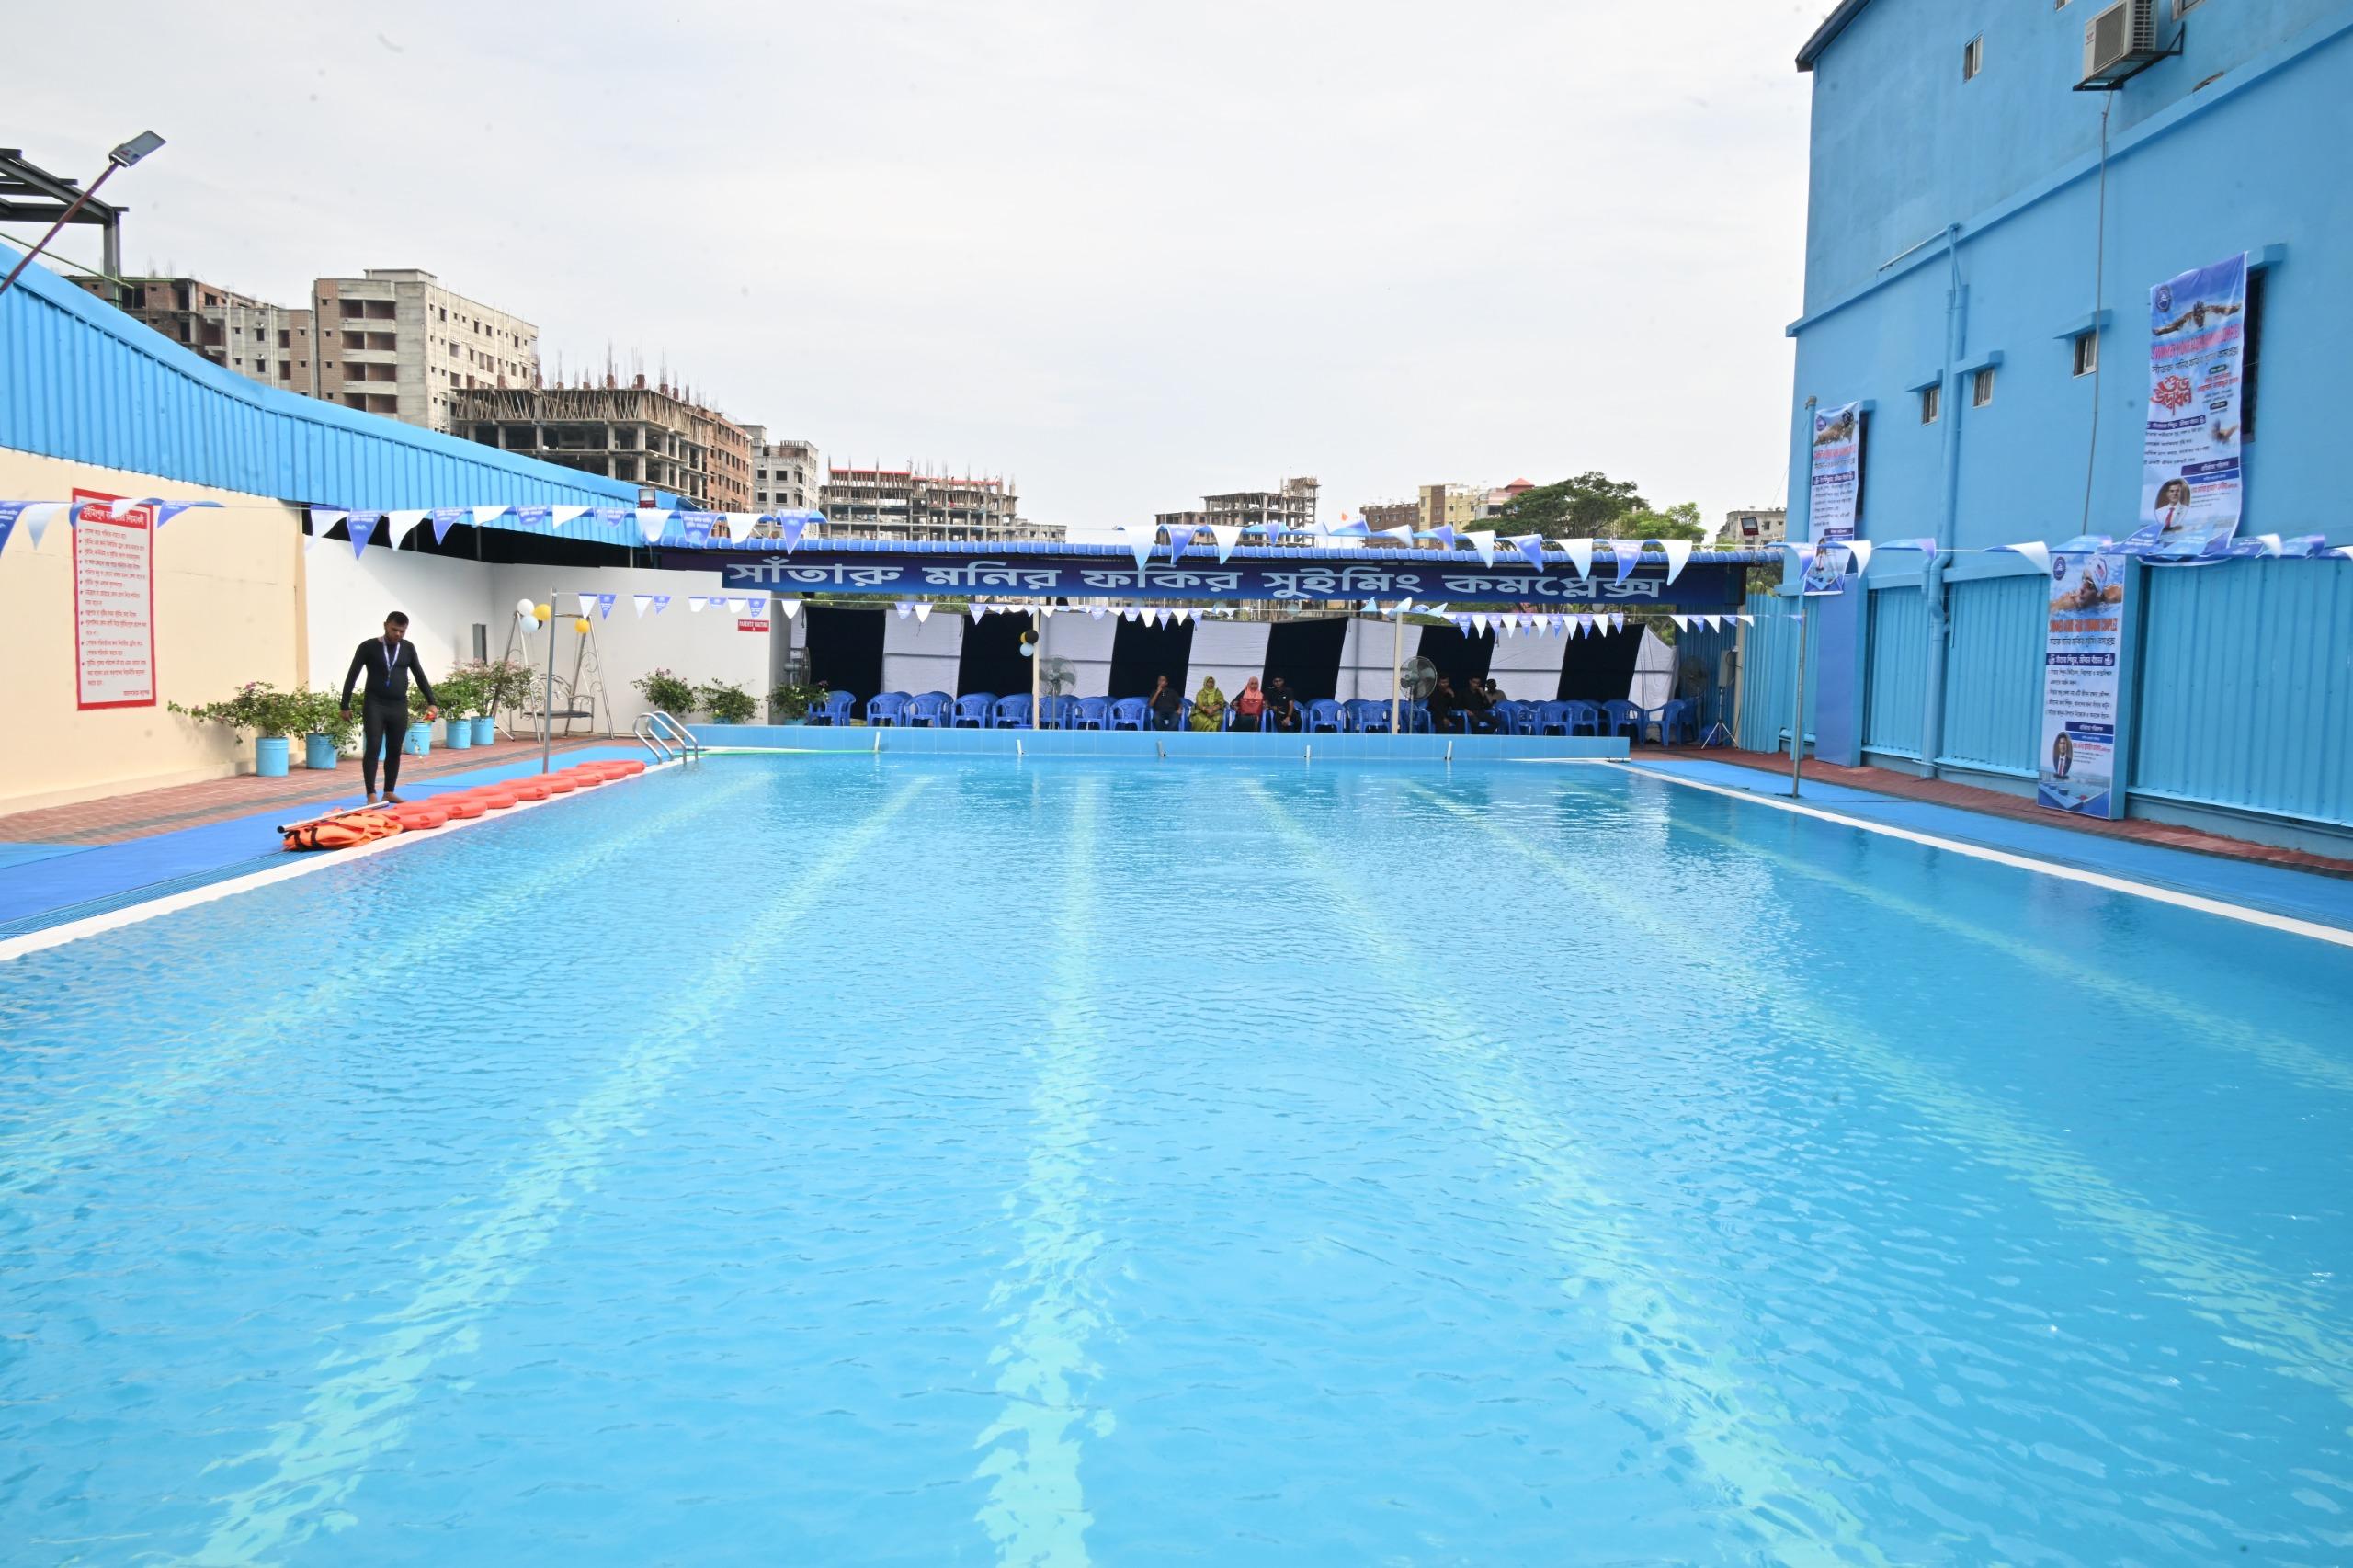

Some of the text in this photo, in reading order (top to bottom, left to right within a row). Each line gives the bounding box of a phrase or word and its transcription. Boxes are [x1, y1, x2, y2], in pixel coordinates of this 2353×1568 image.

[2157, 375, 2190, 392] শুভ
[726, 556, 1665, 599] সাঁতারু মনির ফকির সুইমিং কমপ্লেক্স
